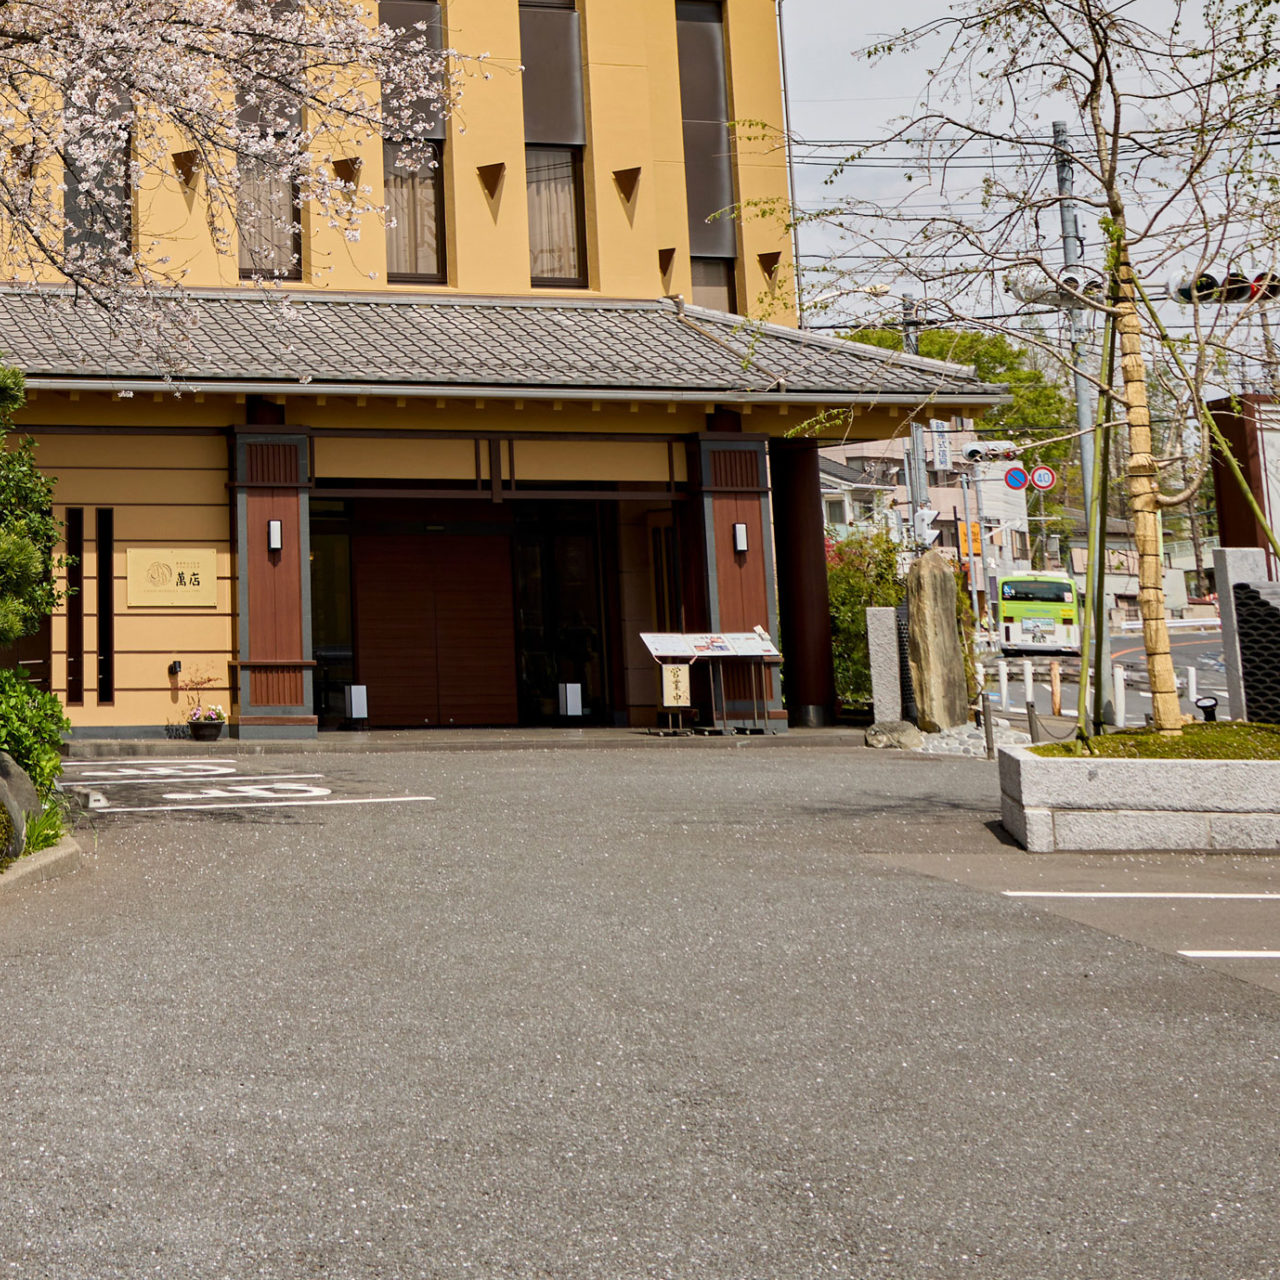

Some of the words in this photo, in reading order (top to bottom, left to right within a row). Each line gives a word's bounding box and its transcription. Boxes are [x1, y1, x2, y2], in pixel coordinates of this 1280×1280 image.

[1037, 472, 1050, 483] 40
[176, 571, 200, 587] 萬店
[670, 666, 682, 704] 営業中
